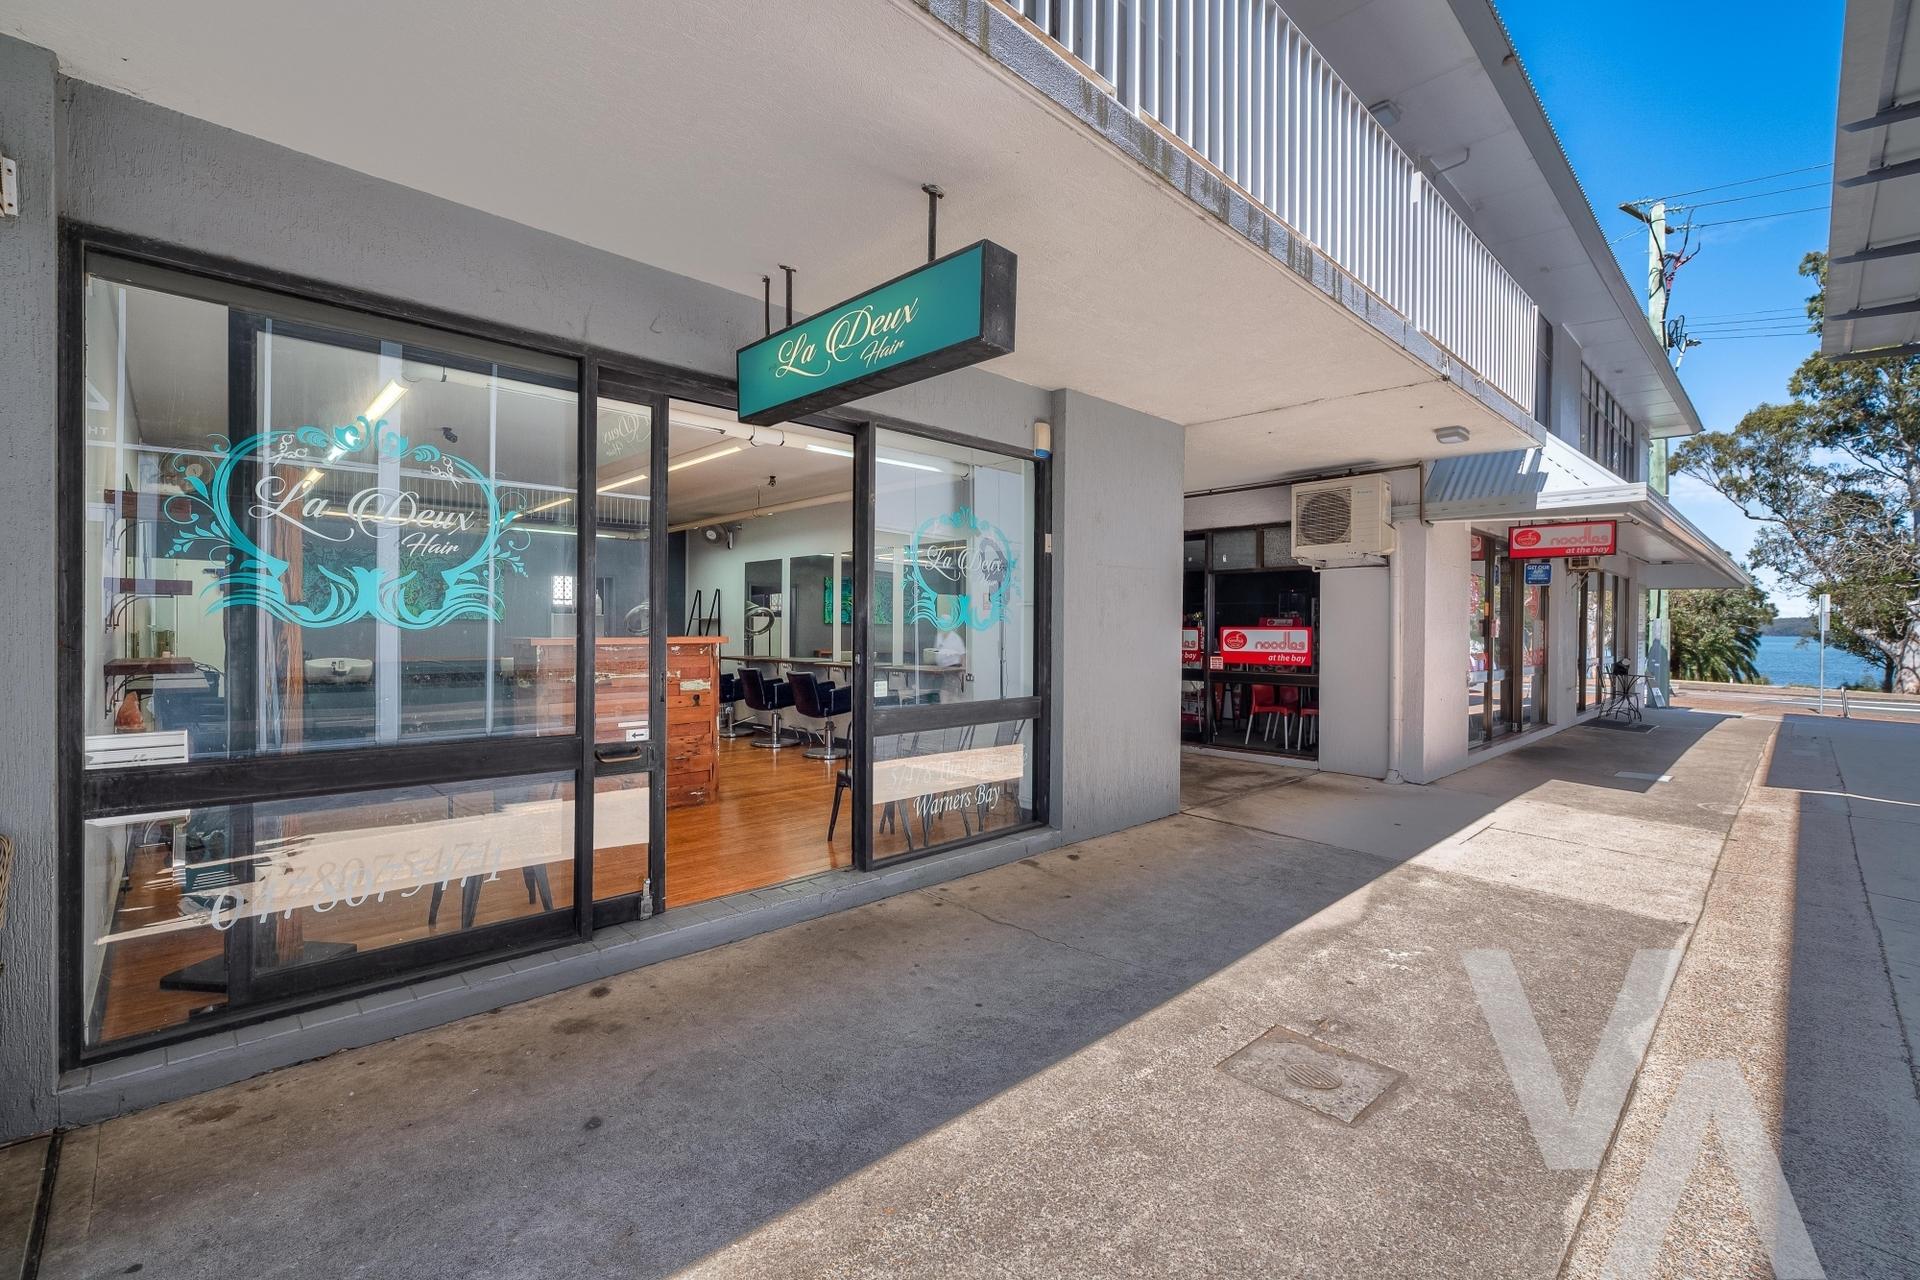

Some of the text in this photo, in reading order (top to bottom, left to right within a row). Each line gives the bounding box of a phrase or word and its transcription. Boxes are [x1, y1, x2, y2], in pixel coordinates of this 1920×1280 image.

[775, 297, 920, 378] La Deux
[860, 336, 905, 369] Hair
[248, 476, 476, 542] La Deux
[401, 530, 460, 557] Hair
[1550, 526, 1609, 546] noodles
[925, 545, 961, 581] La
[1576, 546, 1591, 554] the
[1592, 545, 1609, 555] bay
[1255, 631, 1305, 650] noodles
[1184, 651, 1197, 661] bay
[1277, 654, 1290, 662] the
[1291, 655, 1306, 664] bay
[913, 783, 1001, 818] Warners Bay
